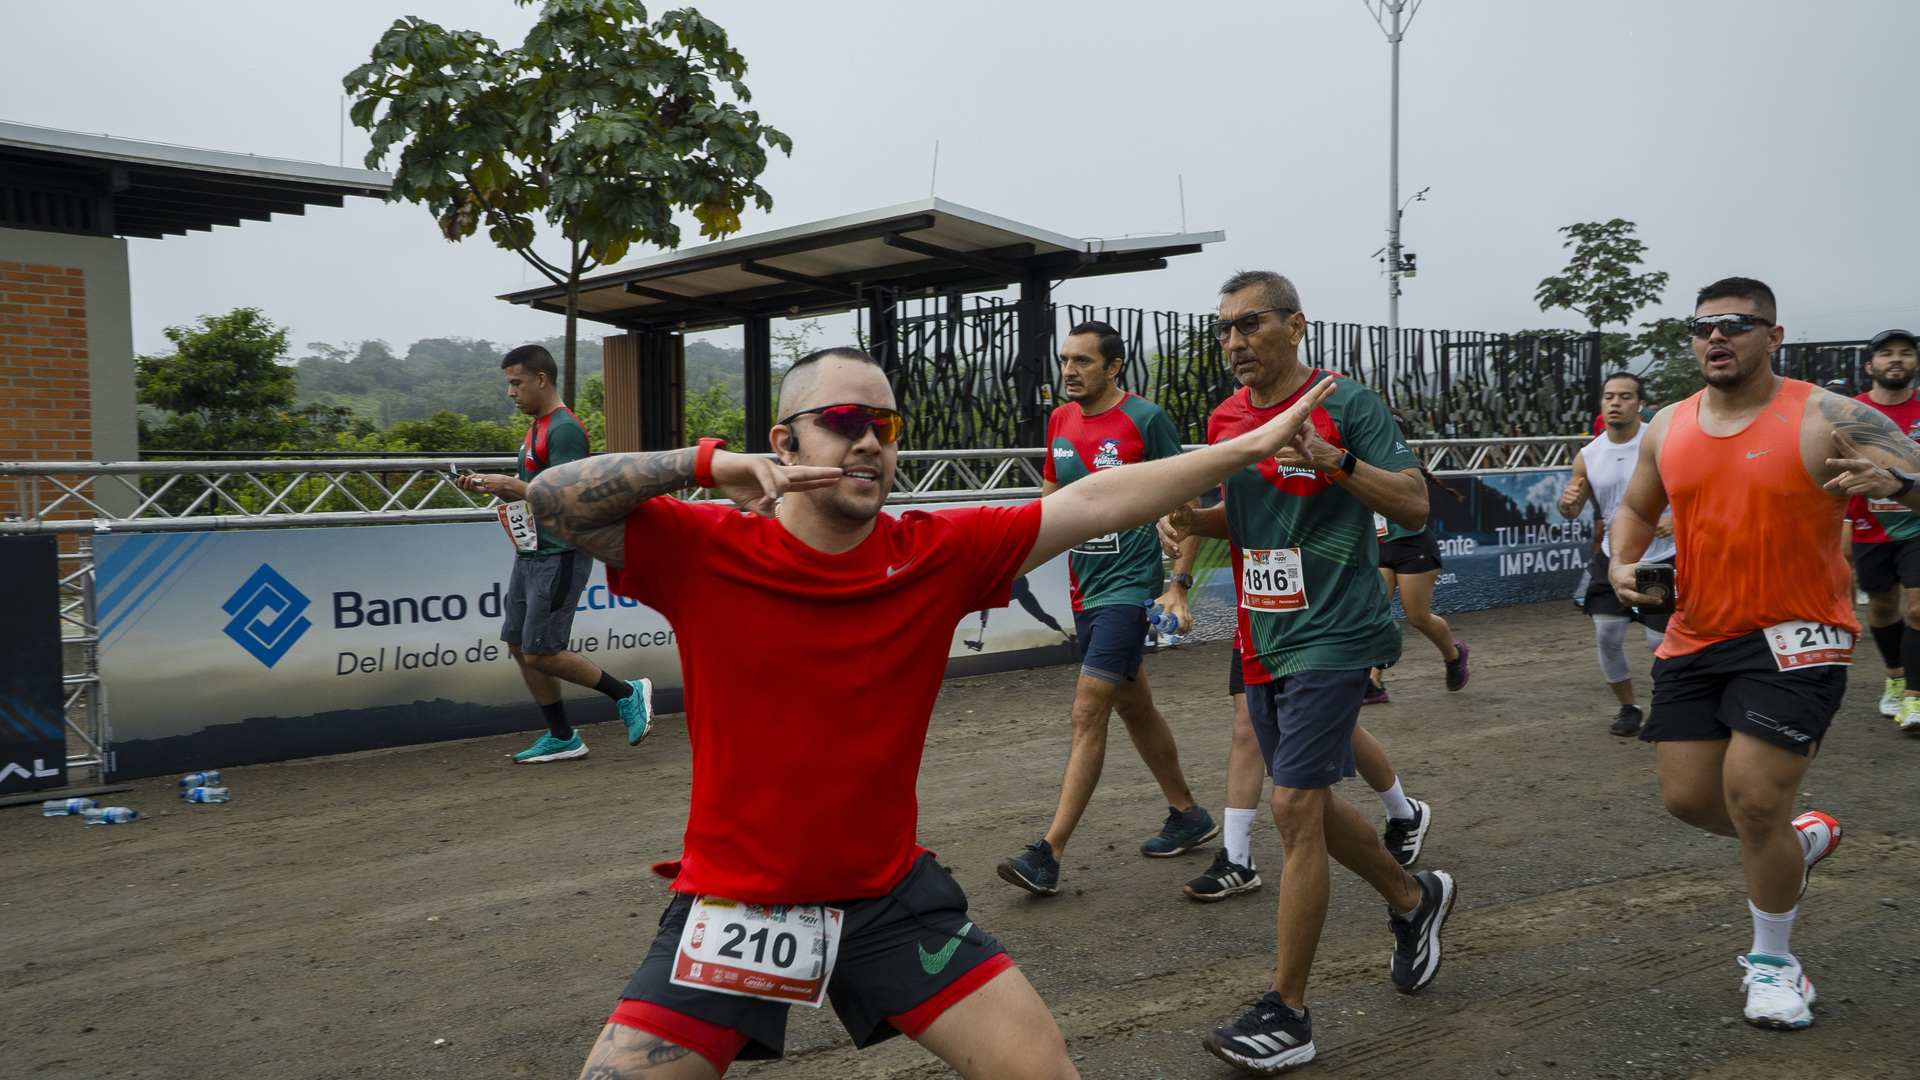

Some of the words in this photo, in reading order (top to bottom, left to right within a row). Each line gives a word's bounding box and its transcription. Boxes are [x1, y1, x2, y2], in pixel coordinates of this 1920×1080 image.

[510, 514, 527, 539] 311
[1495, 526, 1519, 549] TU
[1525, 521, 1587, 545] HACER,
[1437, 535, 1475, 557] ente
[1500, 547, 1588, 577] IMPACTA.
[1245, 567, 1288, 591] 1816
[333, 591, 467, 629] Banco
[1795, 623, 1841, 648] 211
[336, 647, 385, 676] Del
[394, 642, 458, 671] lado
[465, 639, 499, 664] de
[570, 636, 599, 654] ue
[717, 923, 797, 968] 210
